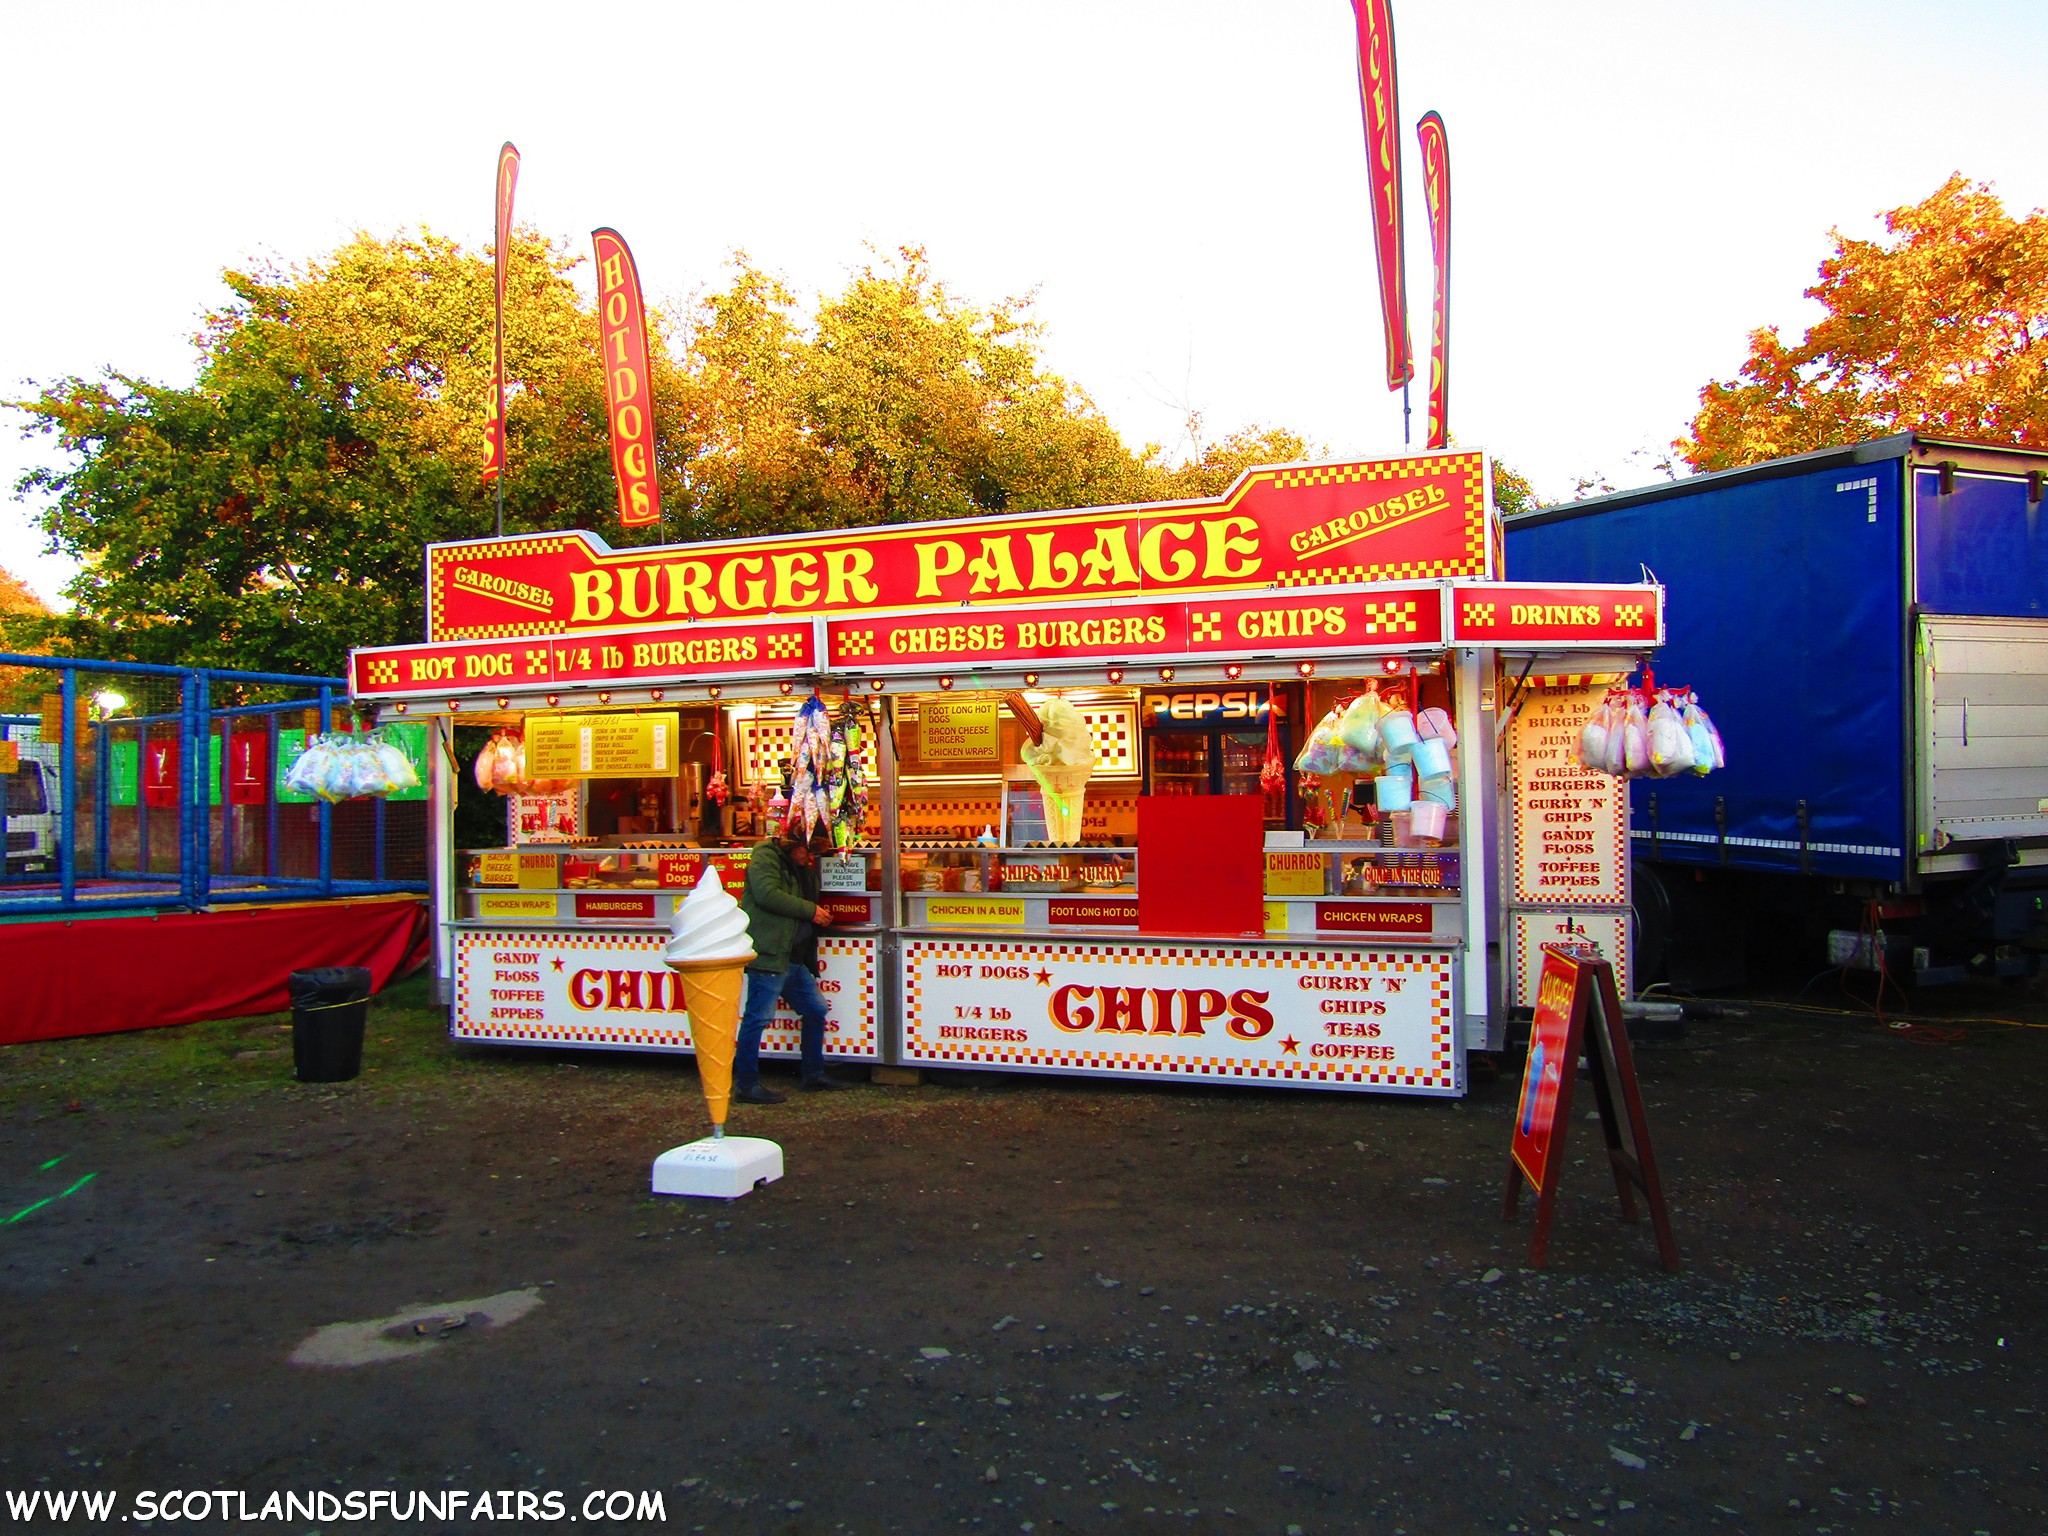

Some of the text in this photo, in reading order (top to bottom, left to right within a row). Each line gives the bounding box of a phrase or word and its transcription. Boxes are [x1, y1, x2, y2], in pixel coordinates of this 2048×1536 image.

[1289, 482, 1446, 553] CAROUSEL
[569, 515, 1263, 623] BURGER PALACE
[454, 566, 554, 607] CAROUSEL
[1510, 604, 1601, 626] DRINKS
[1237, 605, 1347, 640] CHIPS
[889, 615, 1167, 654] CHEESE BURGERS
[556, 648, 592, 672] 1/4
[633, 636, 759, 668] BURGERS
[410, 653, 514, 682] HOT DOG
[1541, 685, 1590, 696] CHIPS
[928, 705, 992, 715] FOOT LONG HOT
[1144, 691, 1258, 720] PEPSI
[1542, 704, 1565, 714] 1/4
[579, 716, 621, 726] MENU
[928, 715, 950, 723] DOGS
[1529, 717, 1588, 727] BURGE
[928, 726, 989, 735] BACON CHEESE
[928, 736, 966, 744] BURGERS
[1540, 735, 1576, 745] JUM
[929, 747, 994, 756] CHICKEN WRAPS
[1527, 749, 1559, 759] HOT
[1529, 780, 1606, 791] BURGERS
[1528, 798, 1582, 809] CURRY
[1543, 812, 1593, 823] CHIPS
[1542, 830, 1595, 841] CANDY
[1543, 844, 1594, 855] FLOSS
[520, 855, 556, 869] CHURROS
[680, 853, 700, 862] Long
[1270, 854, 1321, 870] CHURROS
[669, 862, 691, 872] Hot
[1041, 864, 1071, 882] AND
[1538, 862, 1600, 873] TOFFEE
[485, 874, 515, 882] BURGER
[665, 873, 695, 885] Dogs
[1538, 876, 1600, 887] APPLES
[521, 901, 551, 909] WRAPS
[586, 902, 643, 911] HAMBURGERS
[832, 904, 867, 913] DRINKS
[932, 905, 1020, 915] CHICKEN IN A BUN
[1051, 907, 1074, 916] FOOT
[1076, 907, 1101, 916] LONG
[1103, 908, 1121, 917] HOT
[1324, 911, 1423, 923] CHICKEN WRAPS
[494, 952, 540, 965] CANDY
[495, 970, 540, 983] FLOSS
[936, 963, 1030, 981] HOT DOGS
[1298, 974, 1371, 994] CURRY
[489, 988, 545, 1002] TOFFEE
[568, 968, 688, 1014] CHI
[489, 1006, 545, 1020] APPLES
[953, 1004, 984, 1021] 1/4
[1048, 983, 1275, 1040] CHIPS
[1318, 998, 1388, 1016] CHIPS
[938, 1025, 1029, 1043] BURGERS
[1323, 1020, 1382, 1038] TEAS
[1310, 1042, 1396, 1061] COFFEE
